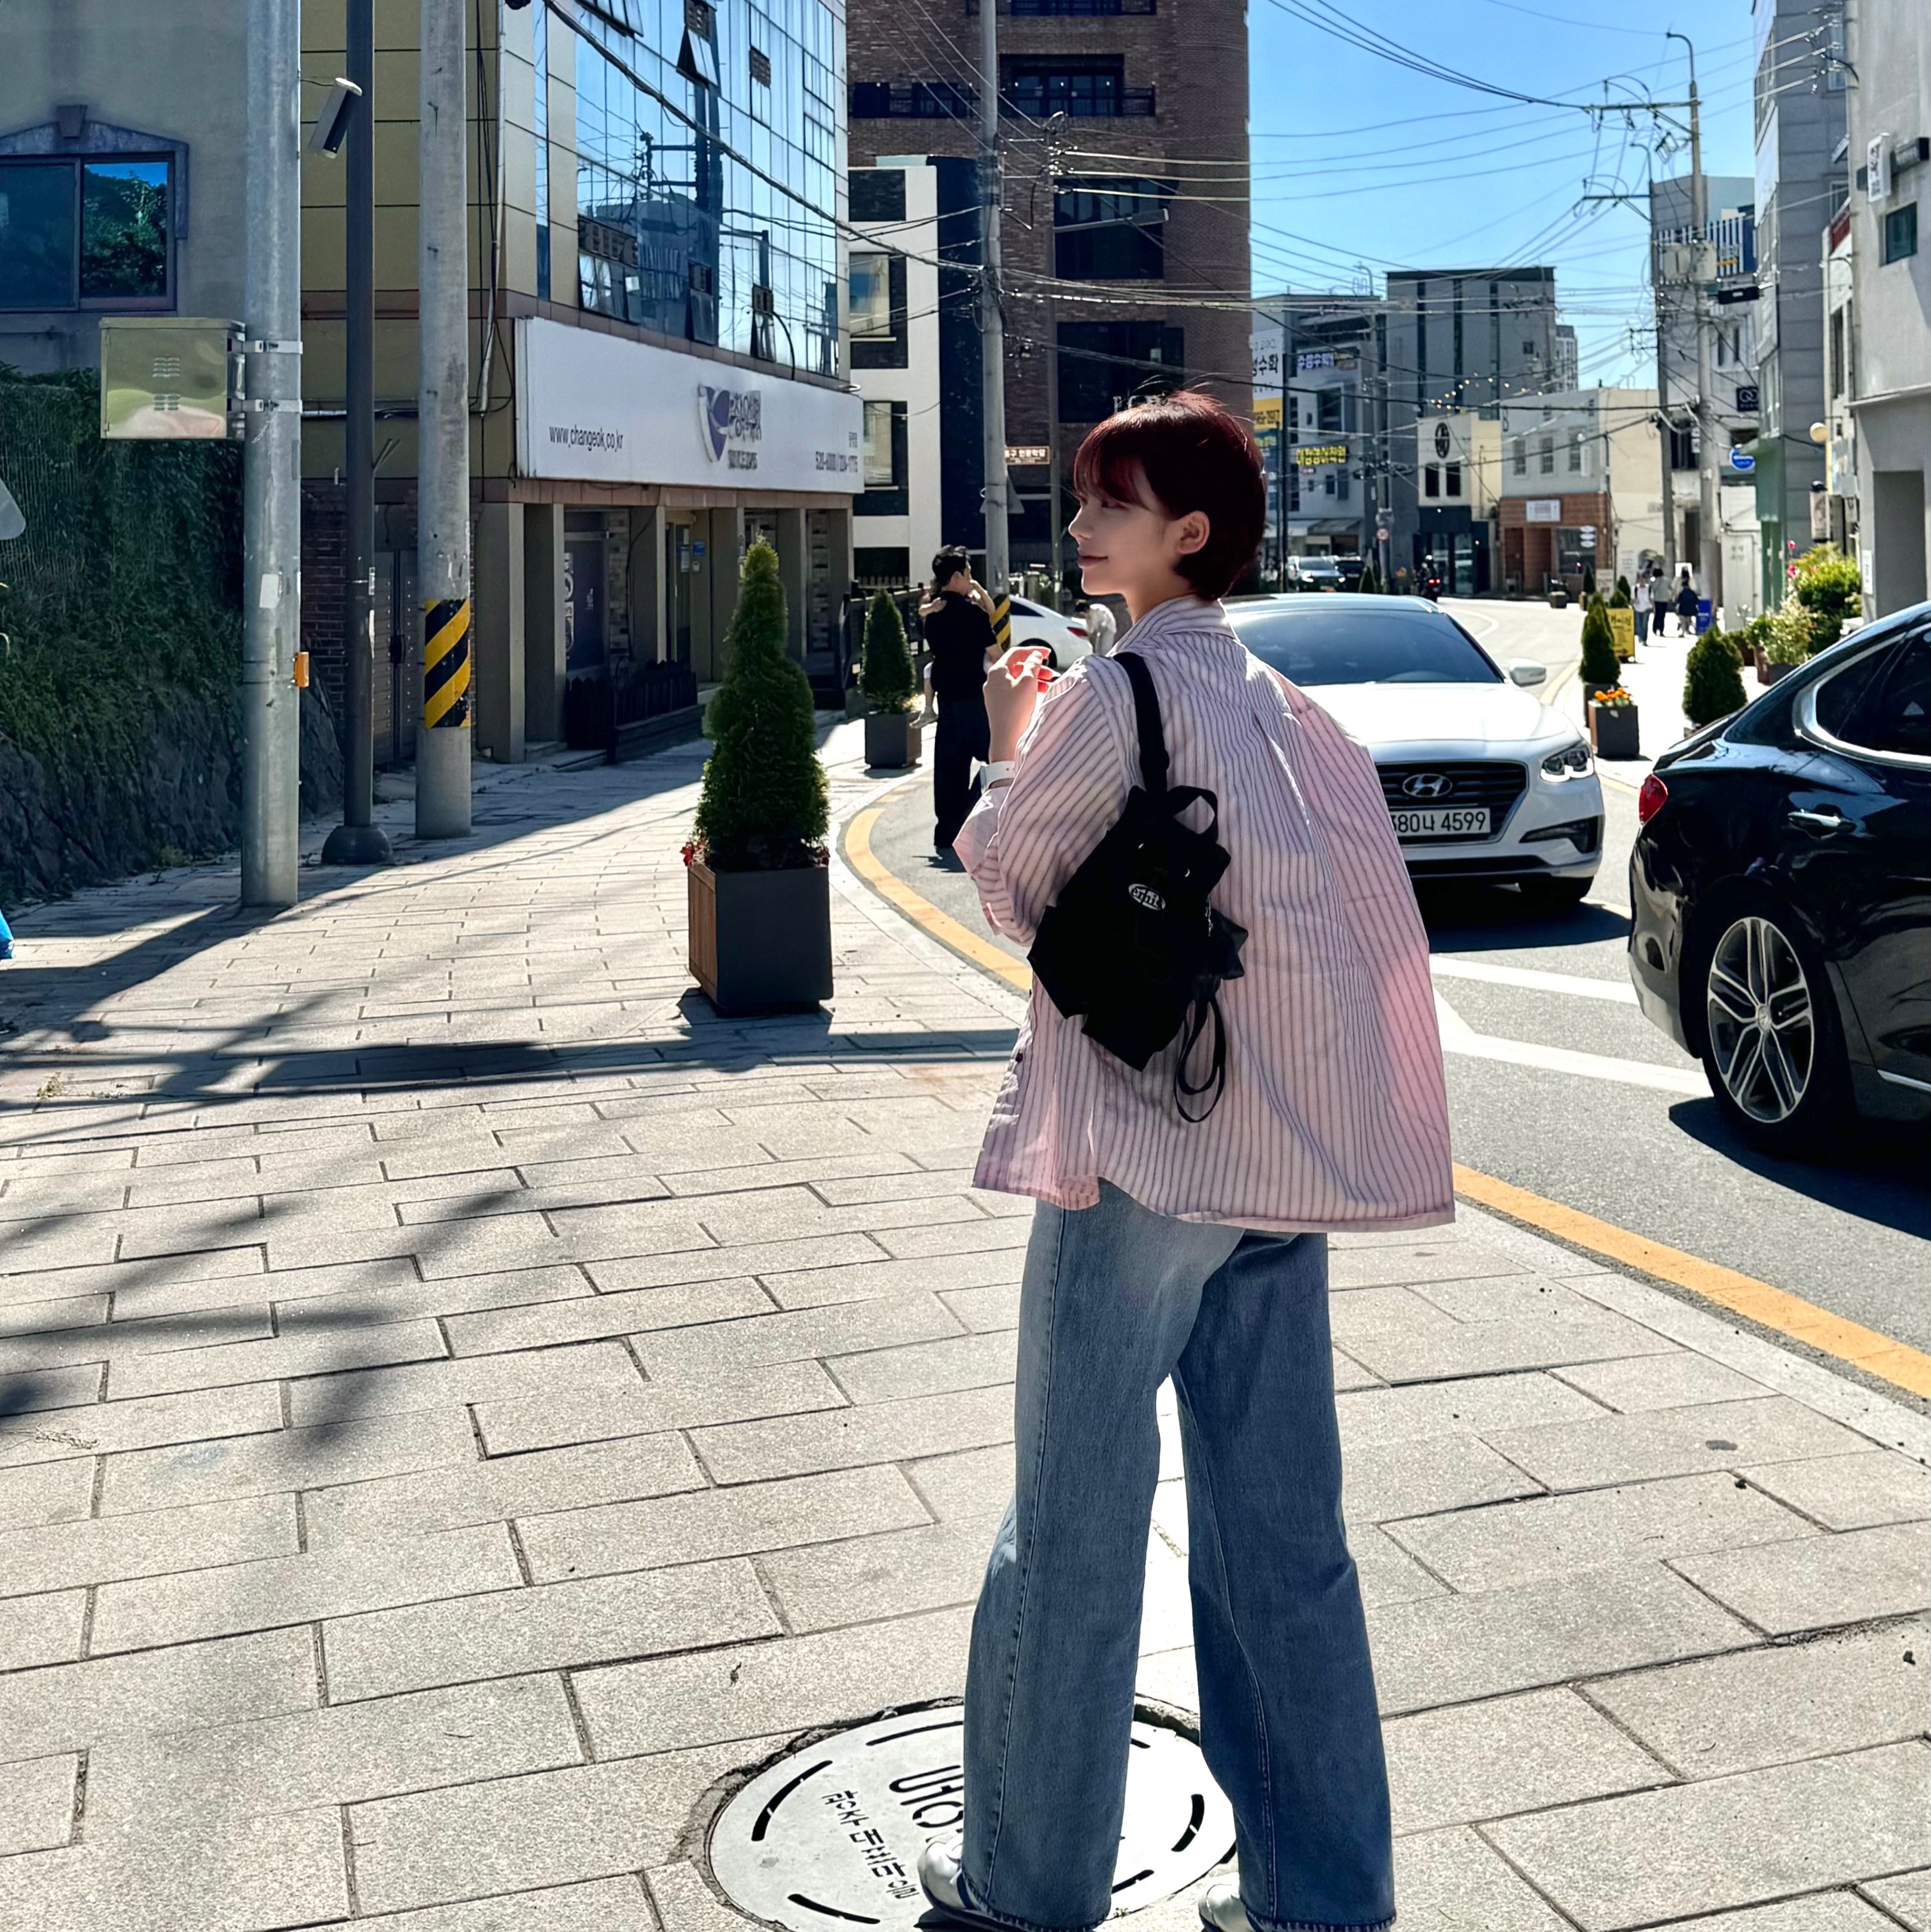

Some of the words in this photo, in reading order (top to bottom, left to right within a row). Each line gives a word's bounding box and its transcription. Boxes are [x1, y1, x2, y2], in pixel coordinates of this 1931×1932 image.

[549, 424, 624, 453] www.changeok.co.kr
[1441, 811, 1486, 832] 4599
[822, 1790, 869, 1826] 광주
[850, 1828, 897, 1866] 대표
[871, 1862, 920, 1899] 마을
